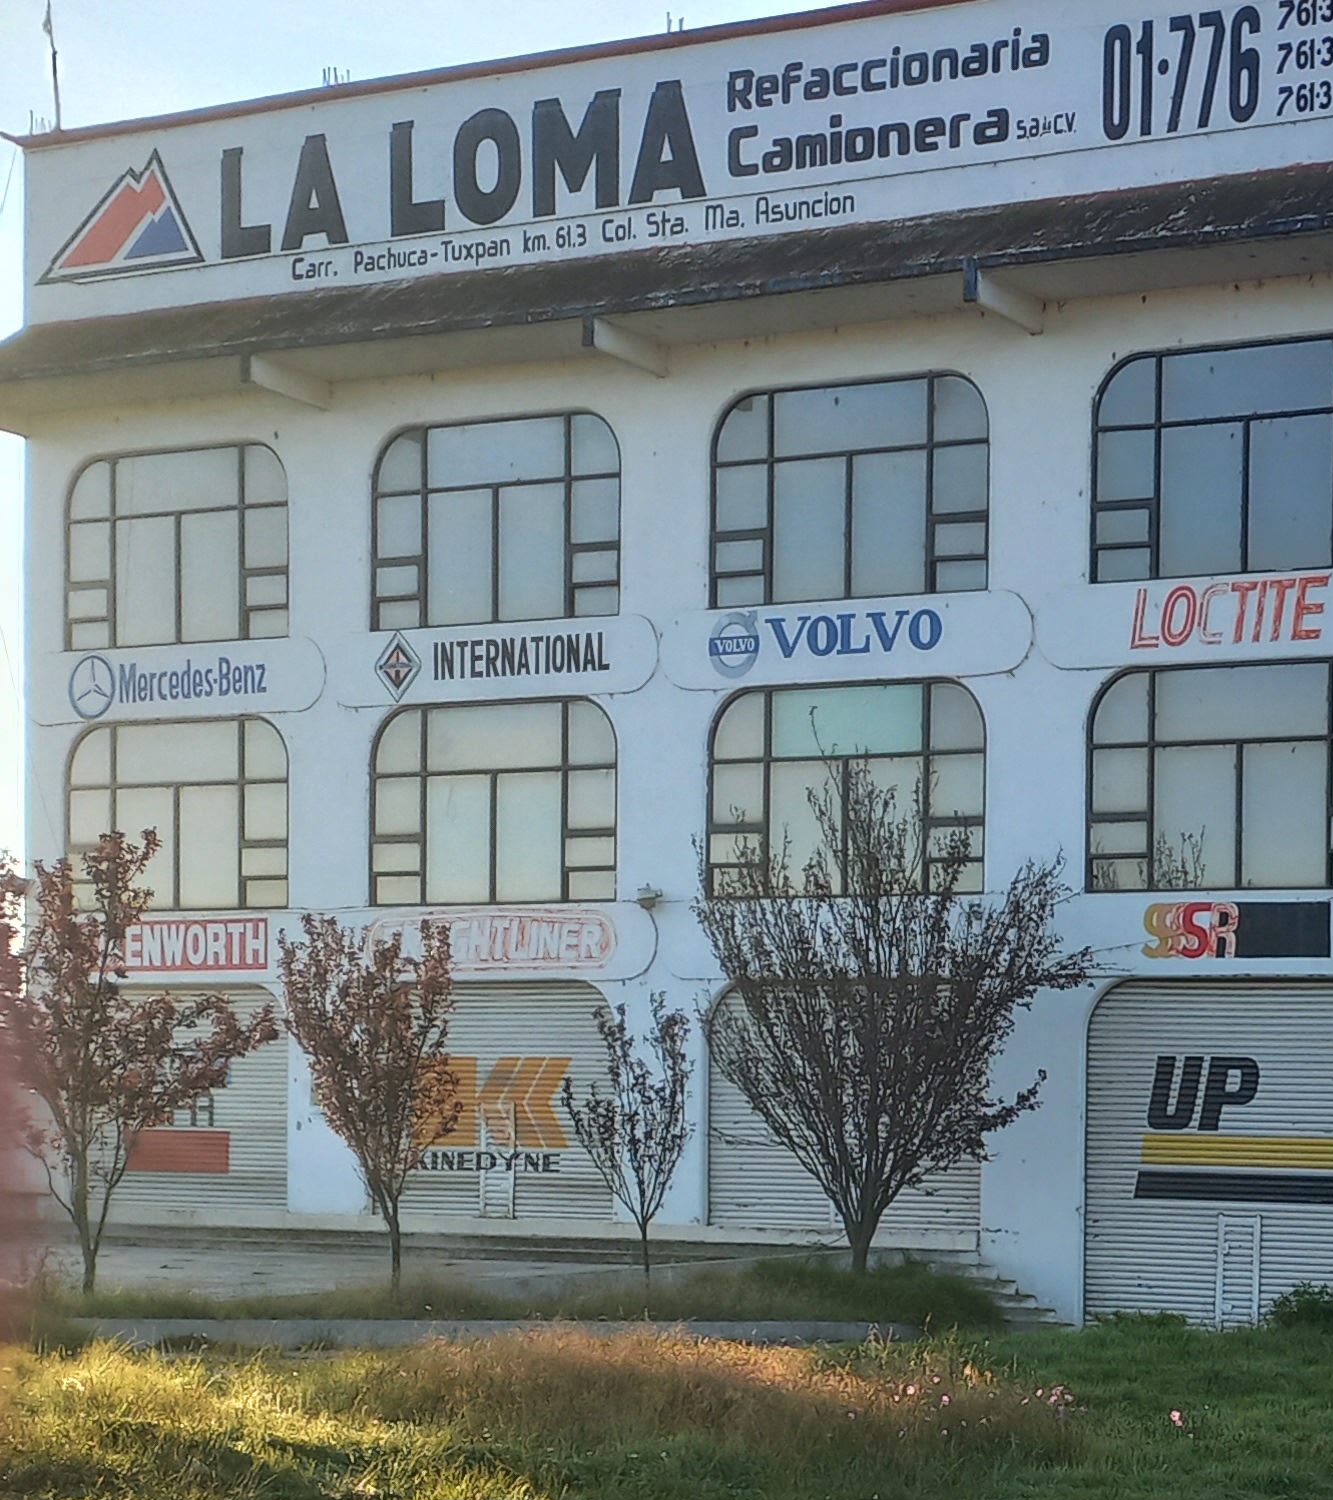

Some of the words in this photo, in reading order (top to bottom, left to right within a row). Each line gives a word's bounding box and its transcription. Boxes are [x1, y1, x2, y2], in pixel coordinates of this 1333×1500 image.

[728, 28, 1050, 112] Refaccionaria
[221, 133, 349, 259] LA
[389, 80, 707, 237] LOMA
[728, 107, 1010, 177] Camionera
[291, 257, 338, 280] Carr.
[353, 238, 511, 273] Pachuca-Tuxpan
[523, 230, 551, 253] km.
[602, 217, 636, 243] Col.
[646, 211, 689, 239] Sta.
[705, 204, 745, 231] Ma.
[756, 191, 855, 225] Asuncion
[714, 637, 755, 654] VOLVO
[765, 608, 943, 659] VOLVO
[1129, 573, 1332, 650] LOCTITE
[118, 657, 267, 704] Mercedes-Benz
[433, 632, 610, 681] INTERNATIONAL
[106, 921, 266, 967] ENWORTH
[1147, 1055, 1260, 1131] UP
